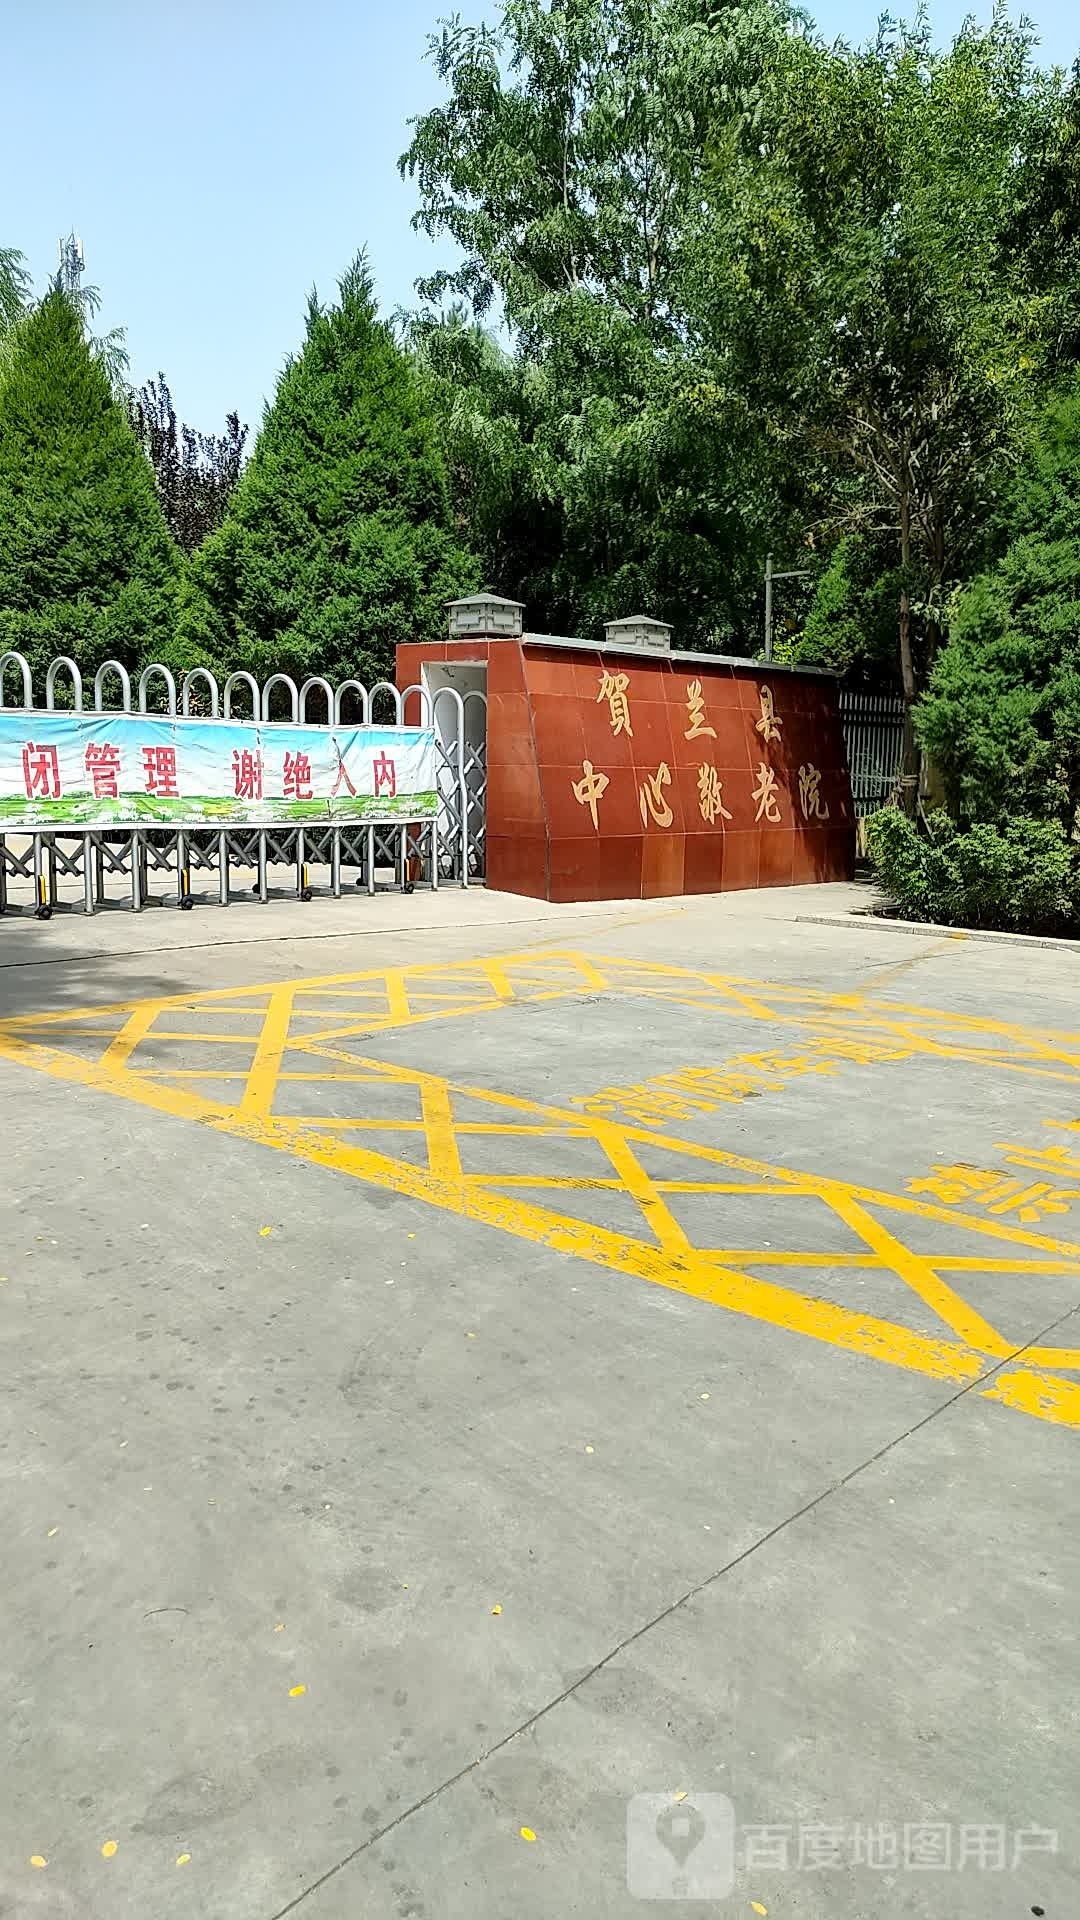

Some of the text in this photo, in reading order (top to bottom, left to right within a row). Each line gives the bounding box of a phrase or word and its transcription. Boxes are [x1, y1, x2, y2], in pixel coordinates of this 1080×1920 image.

[22, 742, 396, 800] 闭管理 谢绝入内
[571, 759, 830, 831] 中心敬老院
